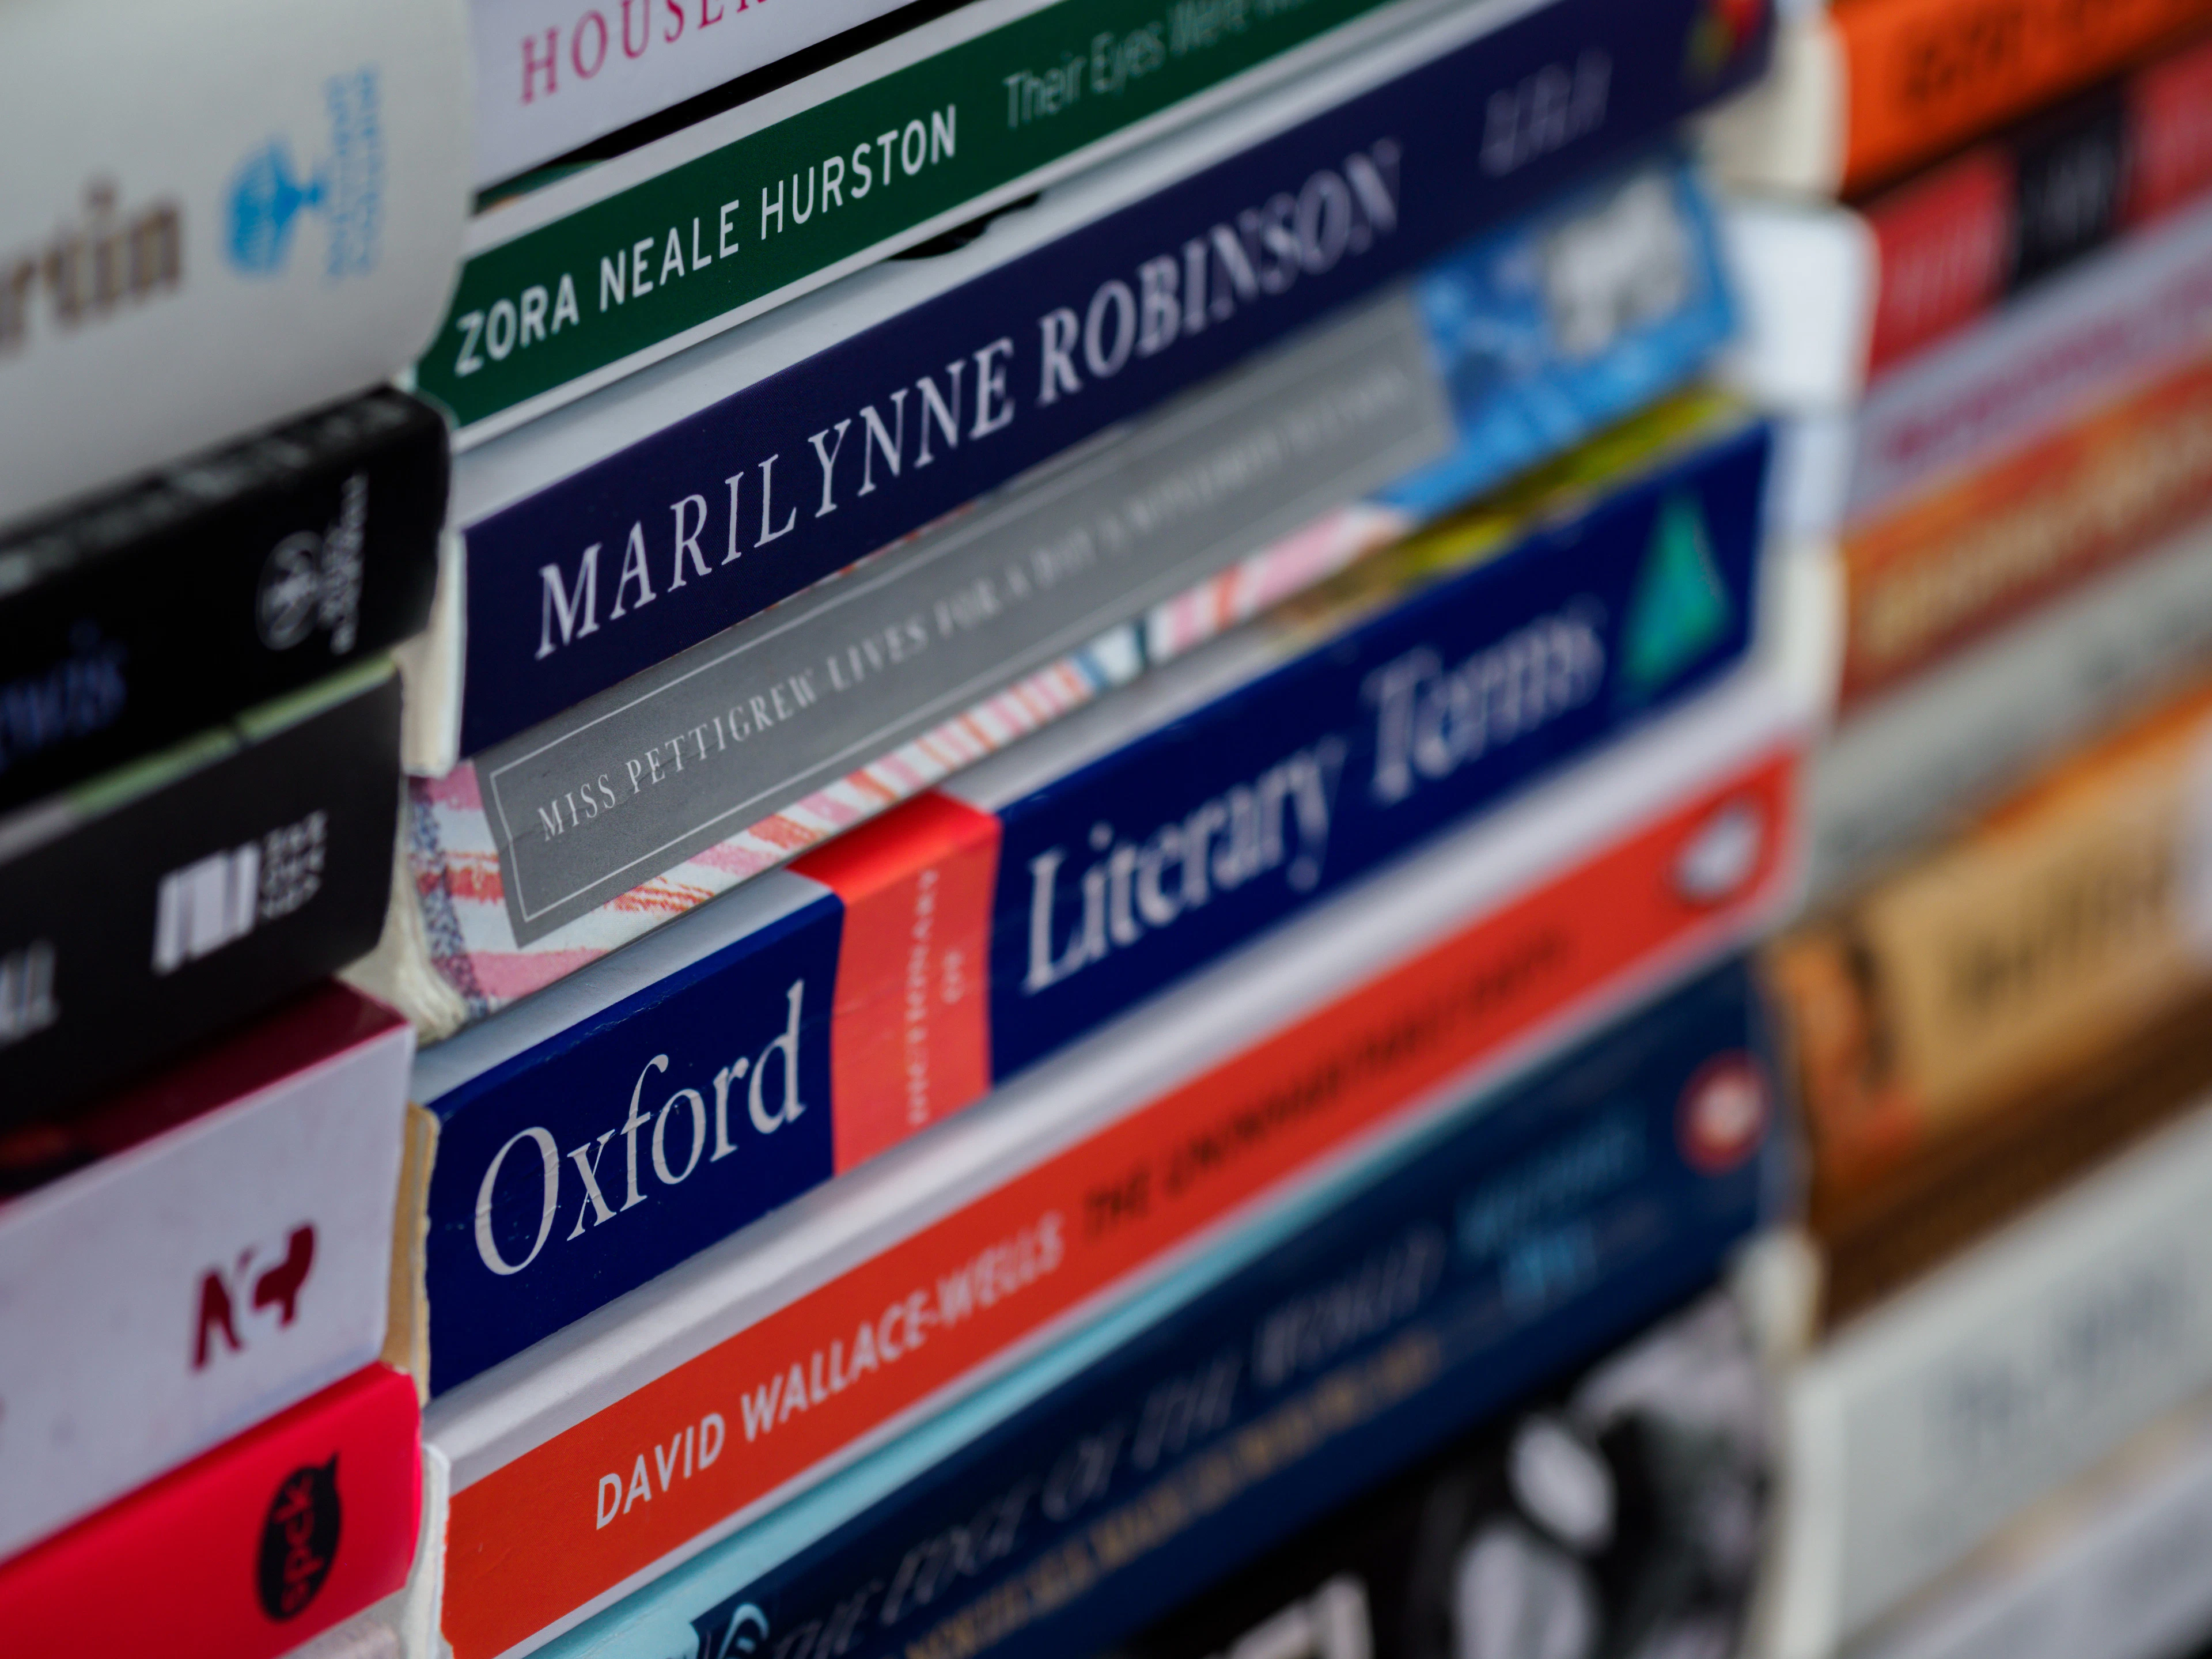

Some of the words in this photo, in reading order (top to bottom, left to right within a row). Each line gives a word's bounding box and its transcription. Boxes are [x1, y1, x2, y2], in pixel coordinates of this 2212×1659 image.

[1003, 51, 1086, 129] Their
[1090, 21, 1166, 98] Eyes
[454, 273, 579, 376] ZORA
[600, 199, 740, 312] NEALE
[760, 104, 956, 240] HURSTON
[535, 337, 1014, 661] MARILYNNE
[1039, 137, 1403, 405] ROBINSON
[537, 773, 617, 842] MISS
[625, 665, 818, 794] PETTIGREW
[827, 612, 930, 692] LIVES
[474, 979, 806, 1276] Oxford
[1022, 733, 1348, 996] Literary
[1358, 593, 1610, 804] Terms
[596, 1412, 725, 1530] DAVID
[740, 1210, 1065, 1442] WALLACE-WELLS
